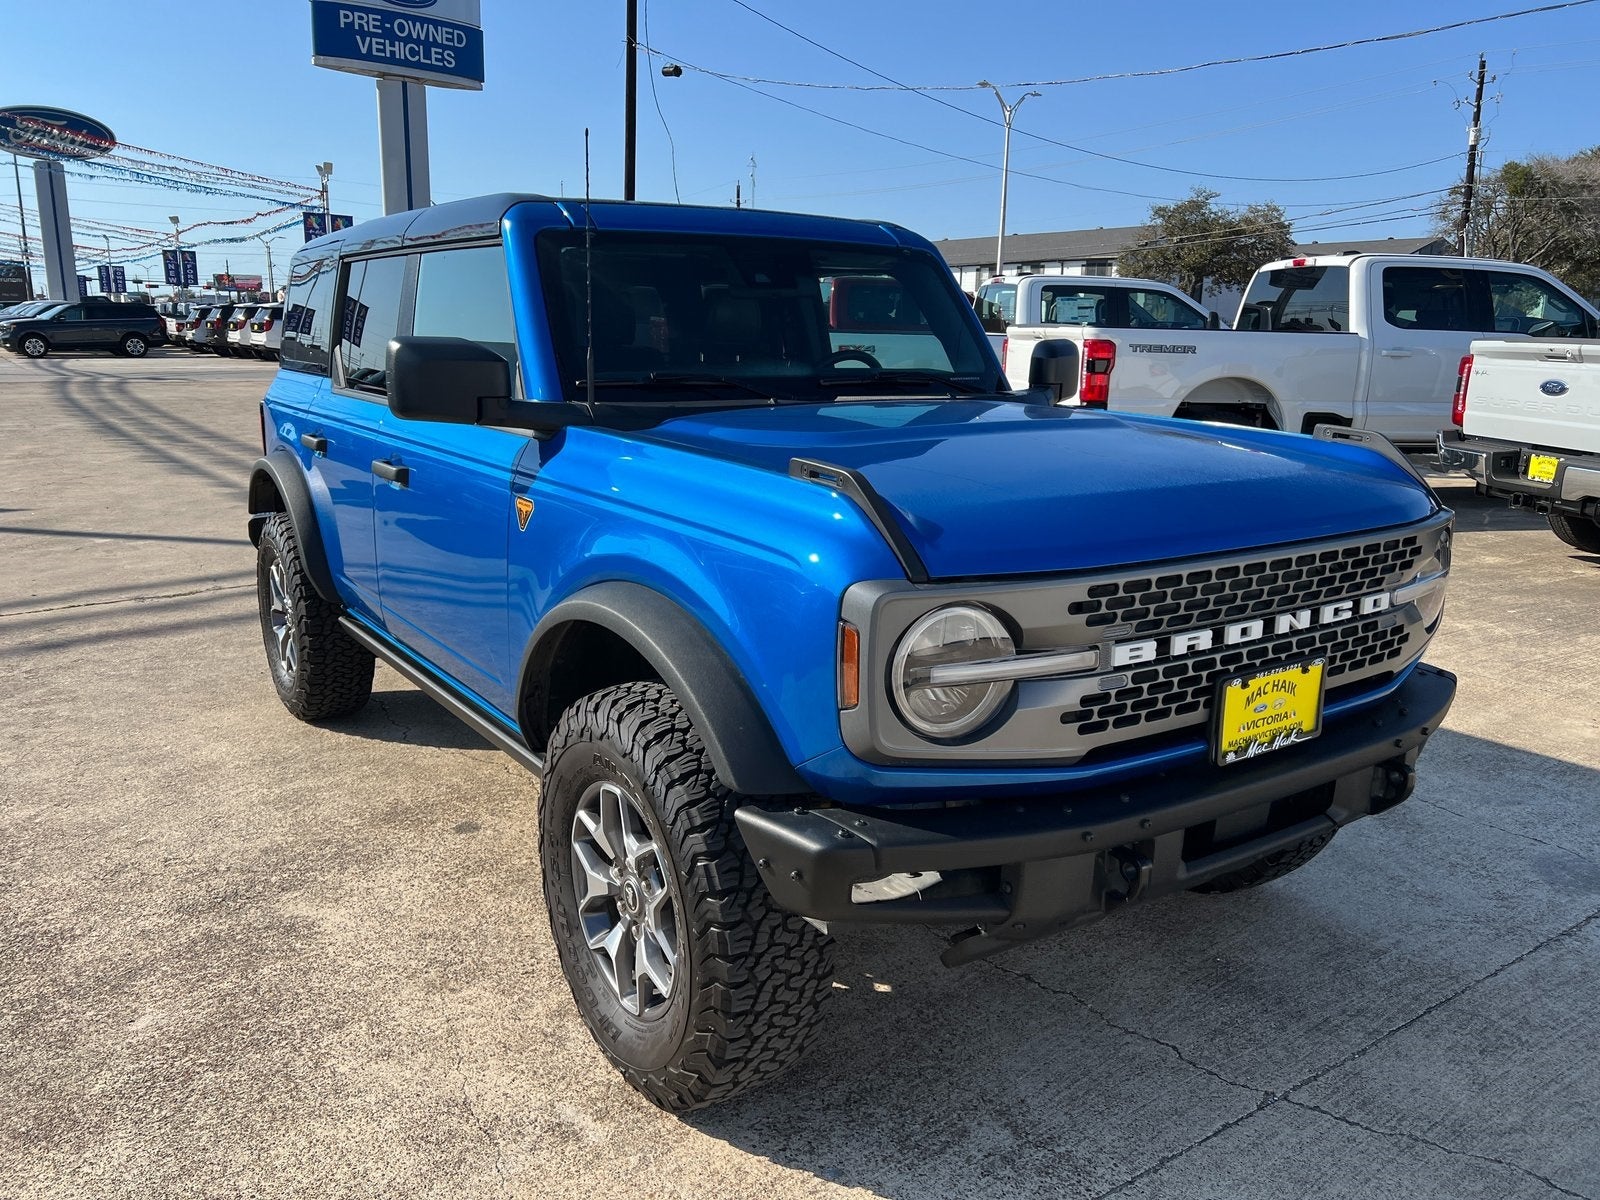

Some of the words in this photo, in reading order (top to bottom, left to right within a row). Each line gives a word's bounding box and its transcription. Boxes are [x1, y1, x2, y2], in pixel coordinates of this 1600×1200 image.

[356, 35, 456, 68] VEHICLES
[168, 263, 177, 284] NEW
[186, 264, 194, 284] FORD
[1129, 344, 1197, 354] TREMOR
[1473, 396, 1558, 414] SUPER
[1112, 592, 1391, 667] BRONCO
[1244, 682, 1270, 709] MAC
[1271, 679, 1297, 697] HAIK
[1246, 711, 1289, 731] VICTORIA
[1245, 741, 1271, 758] Mac
[1272, 730, 1300, 750] Haik
